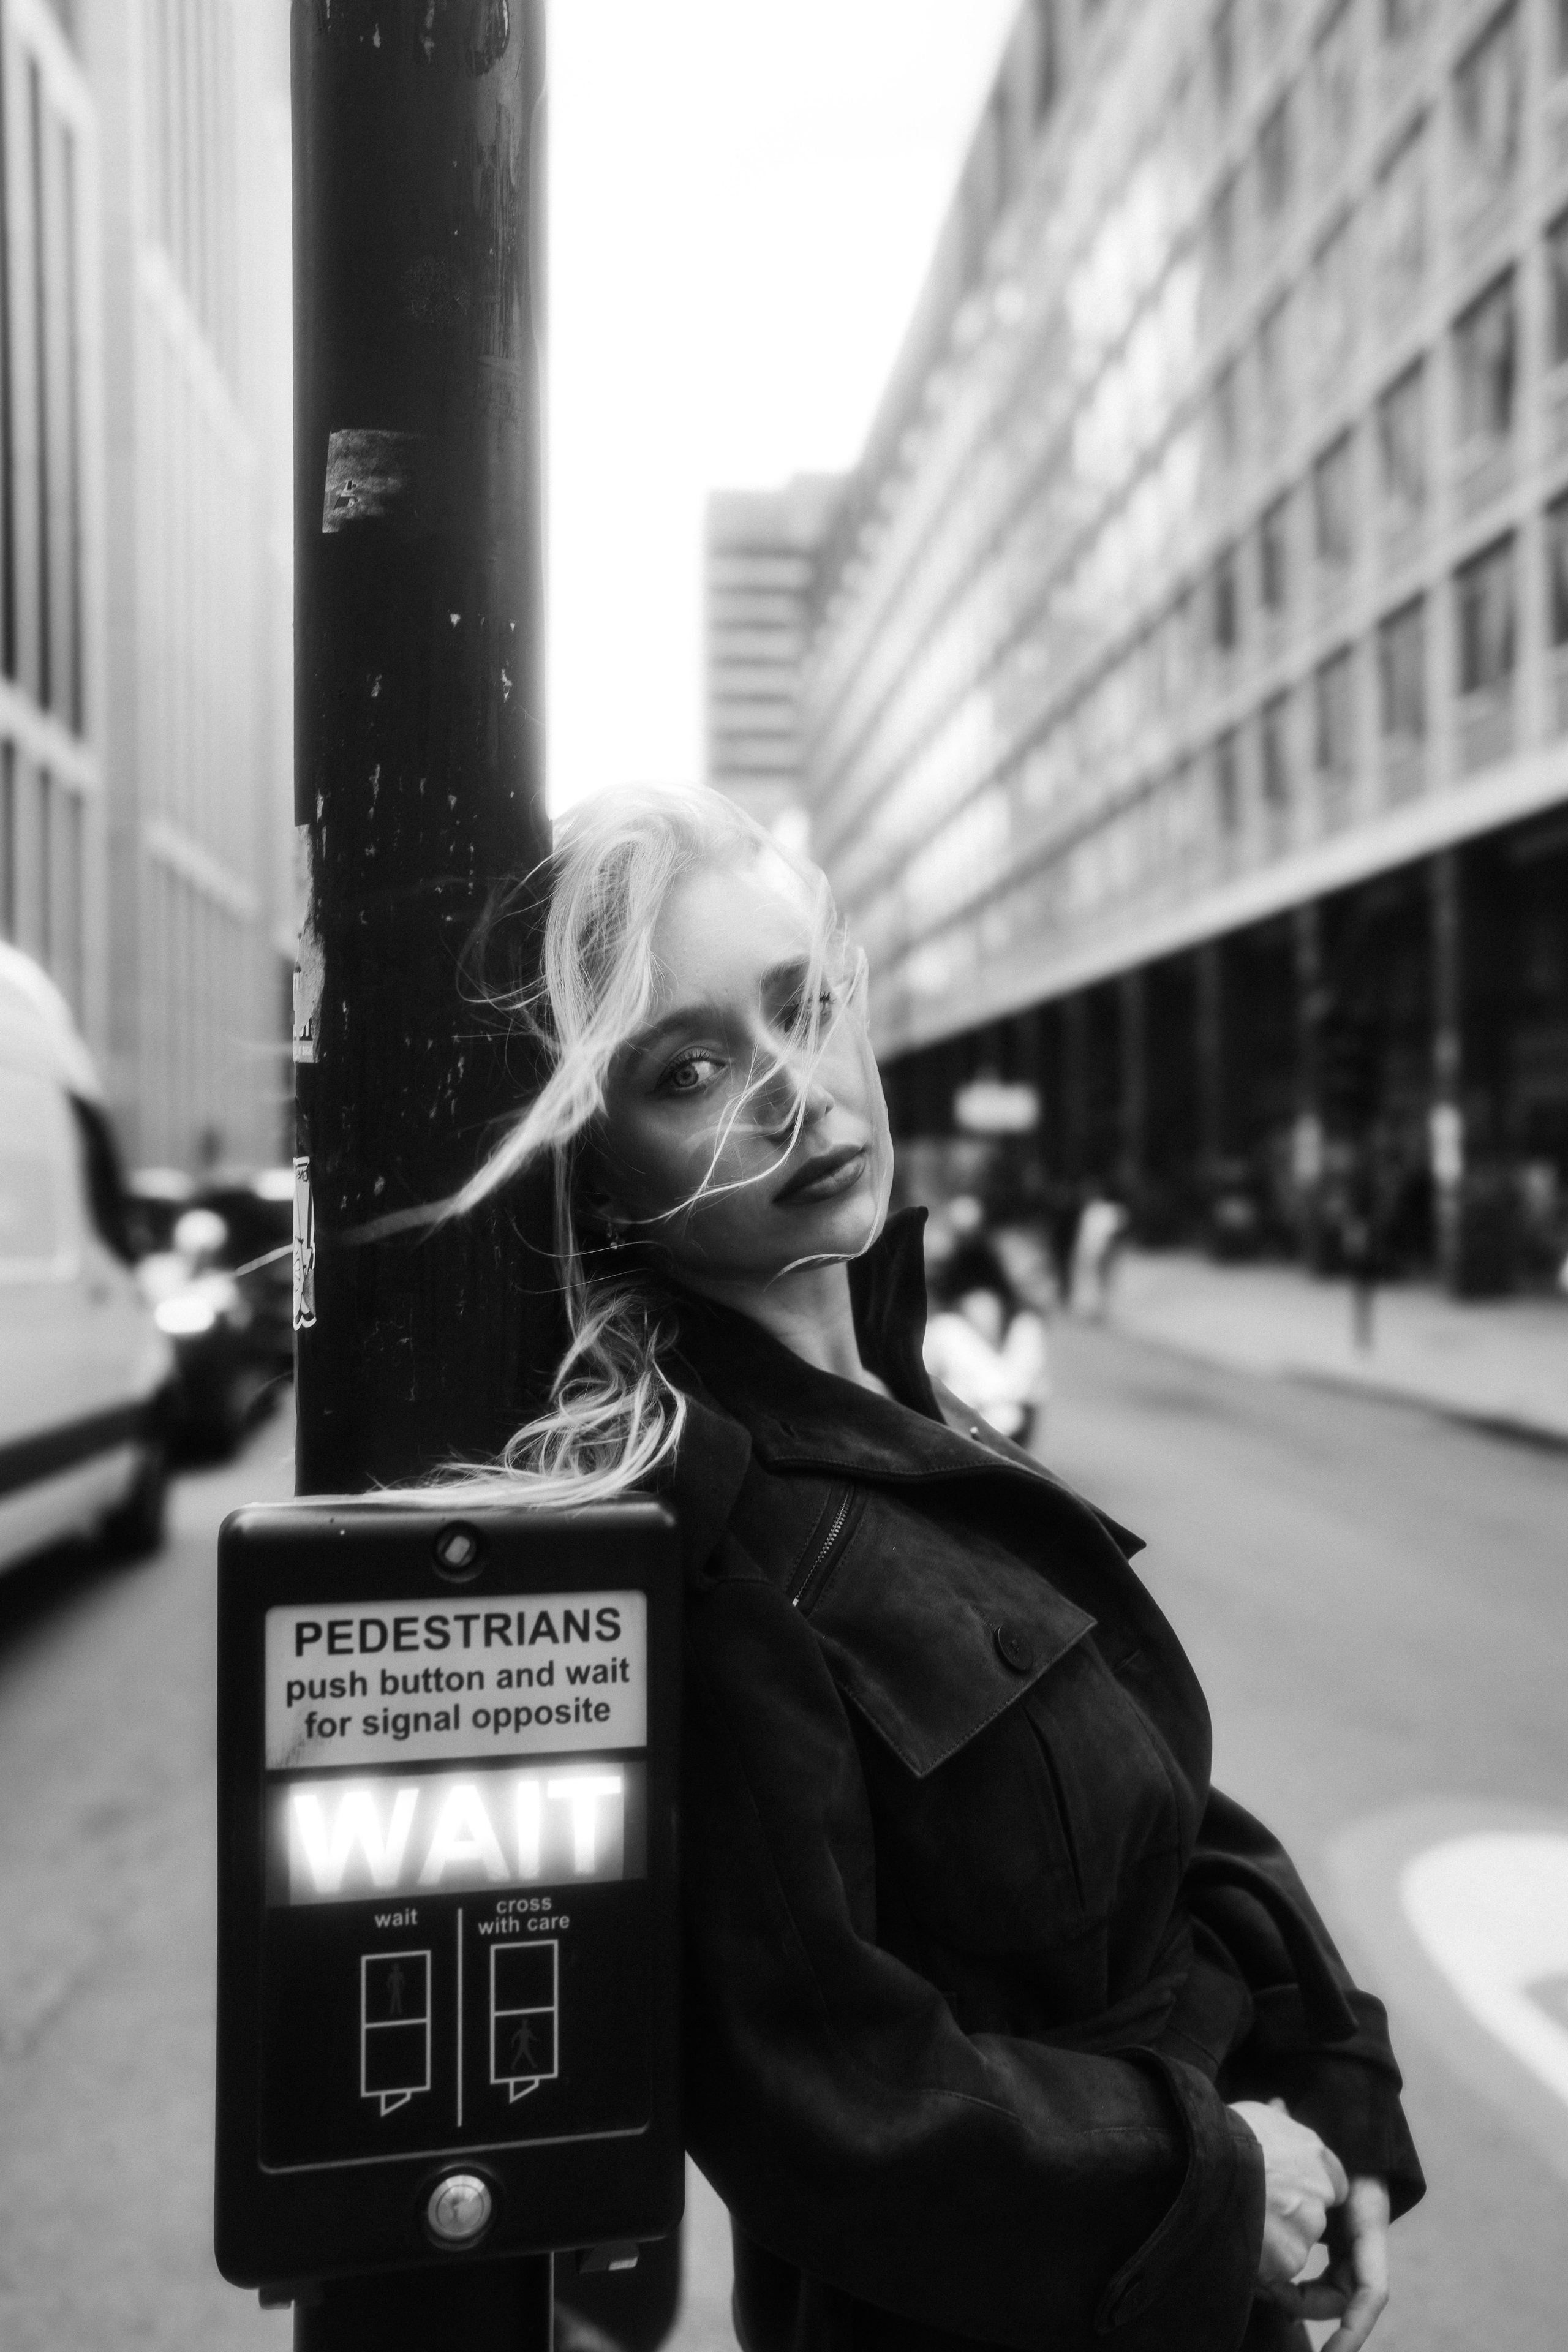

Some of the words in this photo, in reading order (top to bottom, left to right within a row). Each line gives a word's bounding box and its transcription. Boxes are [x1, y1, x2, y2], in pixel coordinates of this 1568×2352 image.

[295, 1607, 621, 1657] PEDESTRIANS
[287, 1671, 368, 1708] push
[380, 1668, 484, 1695] button
[497, 1660, 554, 1689] and
[566, 1657, 630, 1685] wait
[305, 1711, 352, 1740] for
[363, 1704, 459, 1741] signal
[472, 1698, 611, 1735] opposite
[294, 1776, 622, 1893] WAIT
[374, 1909, 418, 1928] wait
[478, 1916, 519, 1935] with
[527, 1915, 570, 1931] care
[496, 1897, 552, 1914] cross
